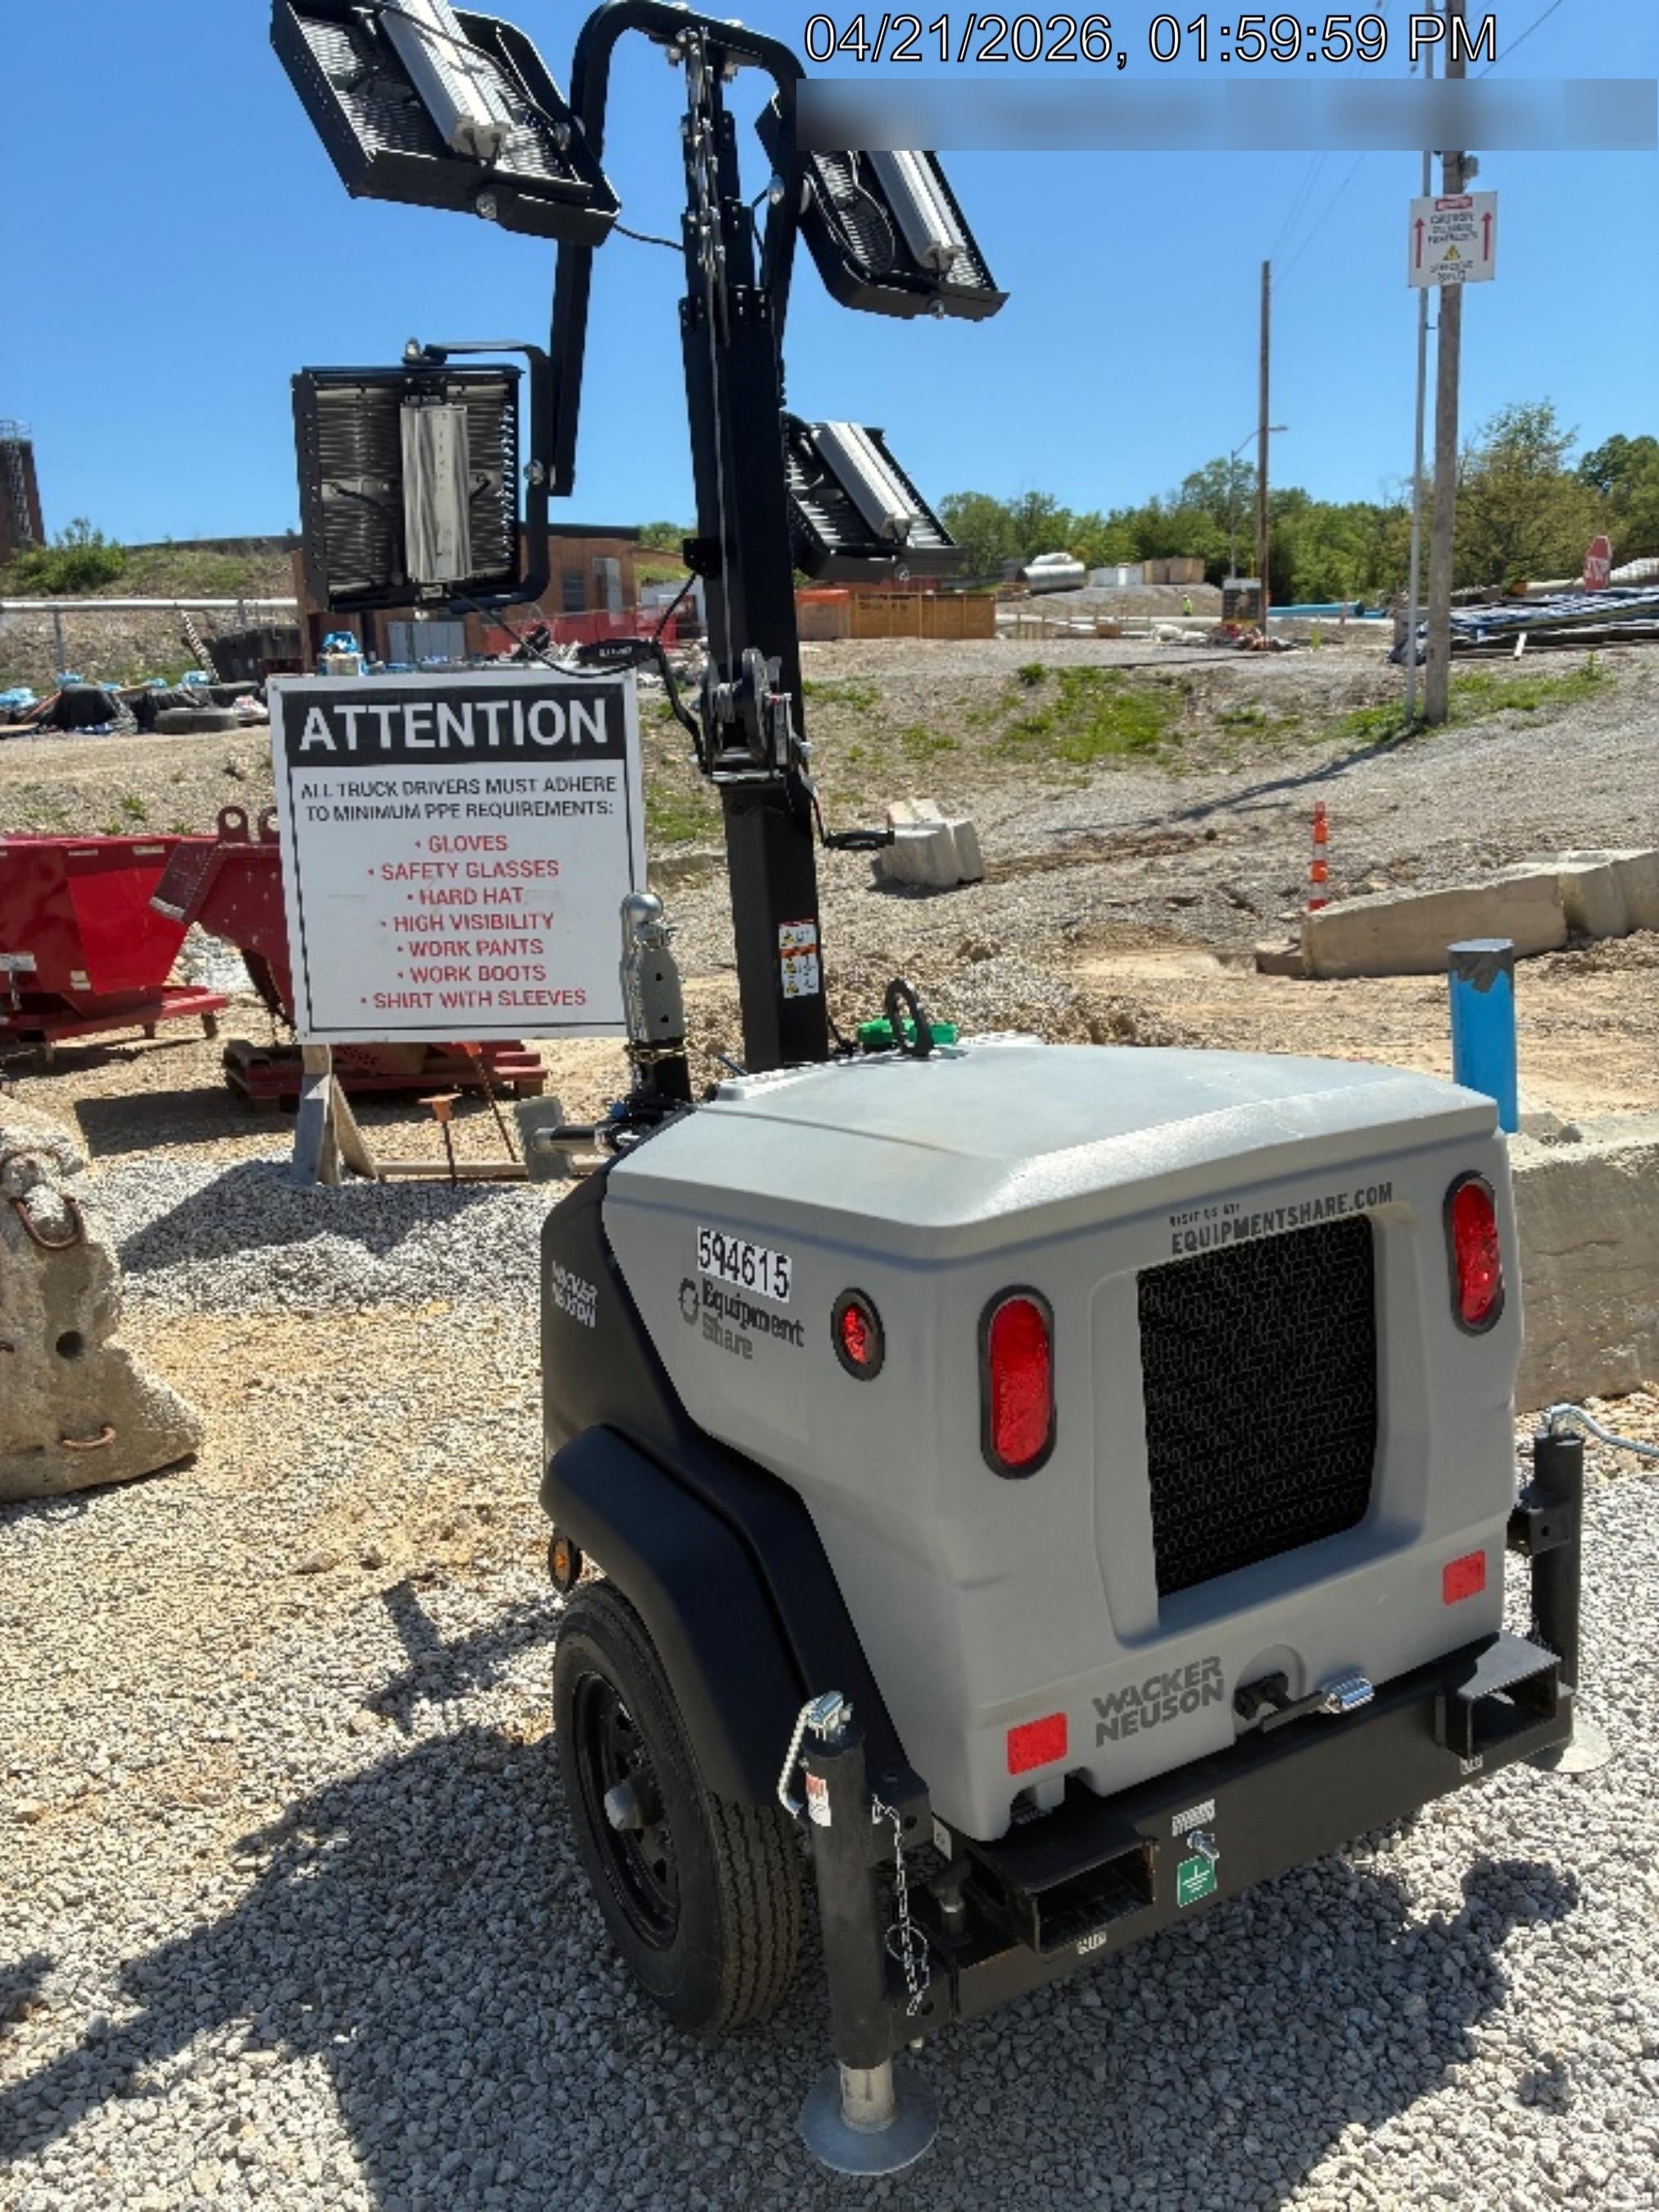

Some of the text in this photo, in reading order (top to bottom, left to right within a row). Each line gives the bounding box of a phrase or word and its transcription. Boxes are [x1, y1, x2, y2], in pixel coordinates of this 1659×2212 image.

[299, 699, 608, 751] ATTENTION
[301, 777, 617, 799] ALL TRUCK DRIVERS MUST ADHERE
[307, 800, 614, 821] TO MINIMUM PPE REQUIREMENTS:
[428, 835, 508, 853] GLOVES
[381, 859, 559, 881] SAFETY GLASSES
[419, 886, 524, 905] HARD HAT
[394, 912, 554, 931] HIGH VISIBILITY
[408, 938, 544, 957] WORK PANTS
[409, 965, 546, 983] WORK BOOTS
[373, 988, 586, 1009] SHIRT WITH SLEEVES
[1172, 1182, 1392, 1254] EQUIPMENTSHARE.COM
[699, 1231, 789, 1298] 594615
[703, 1278, 805, 1347] Equipment
[703, 1312, 753, 1360] Share
[1092, 1656, 1222, 1719] WACKER
[1095, 1678, 1225, 1747] NEUSON
